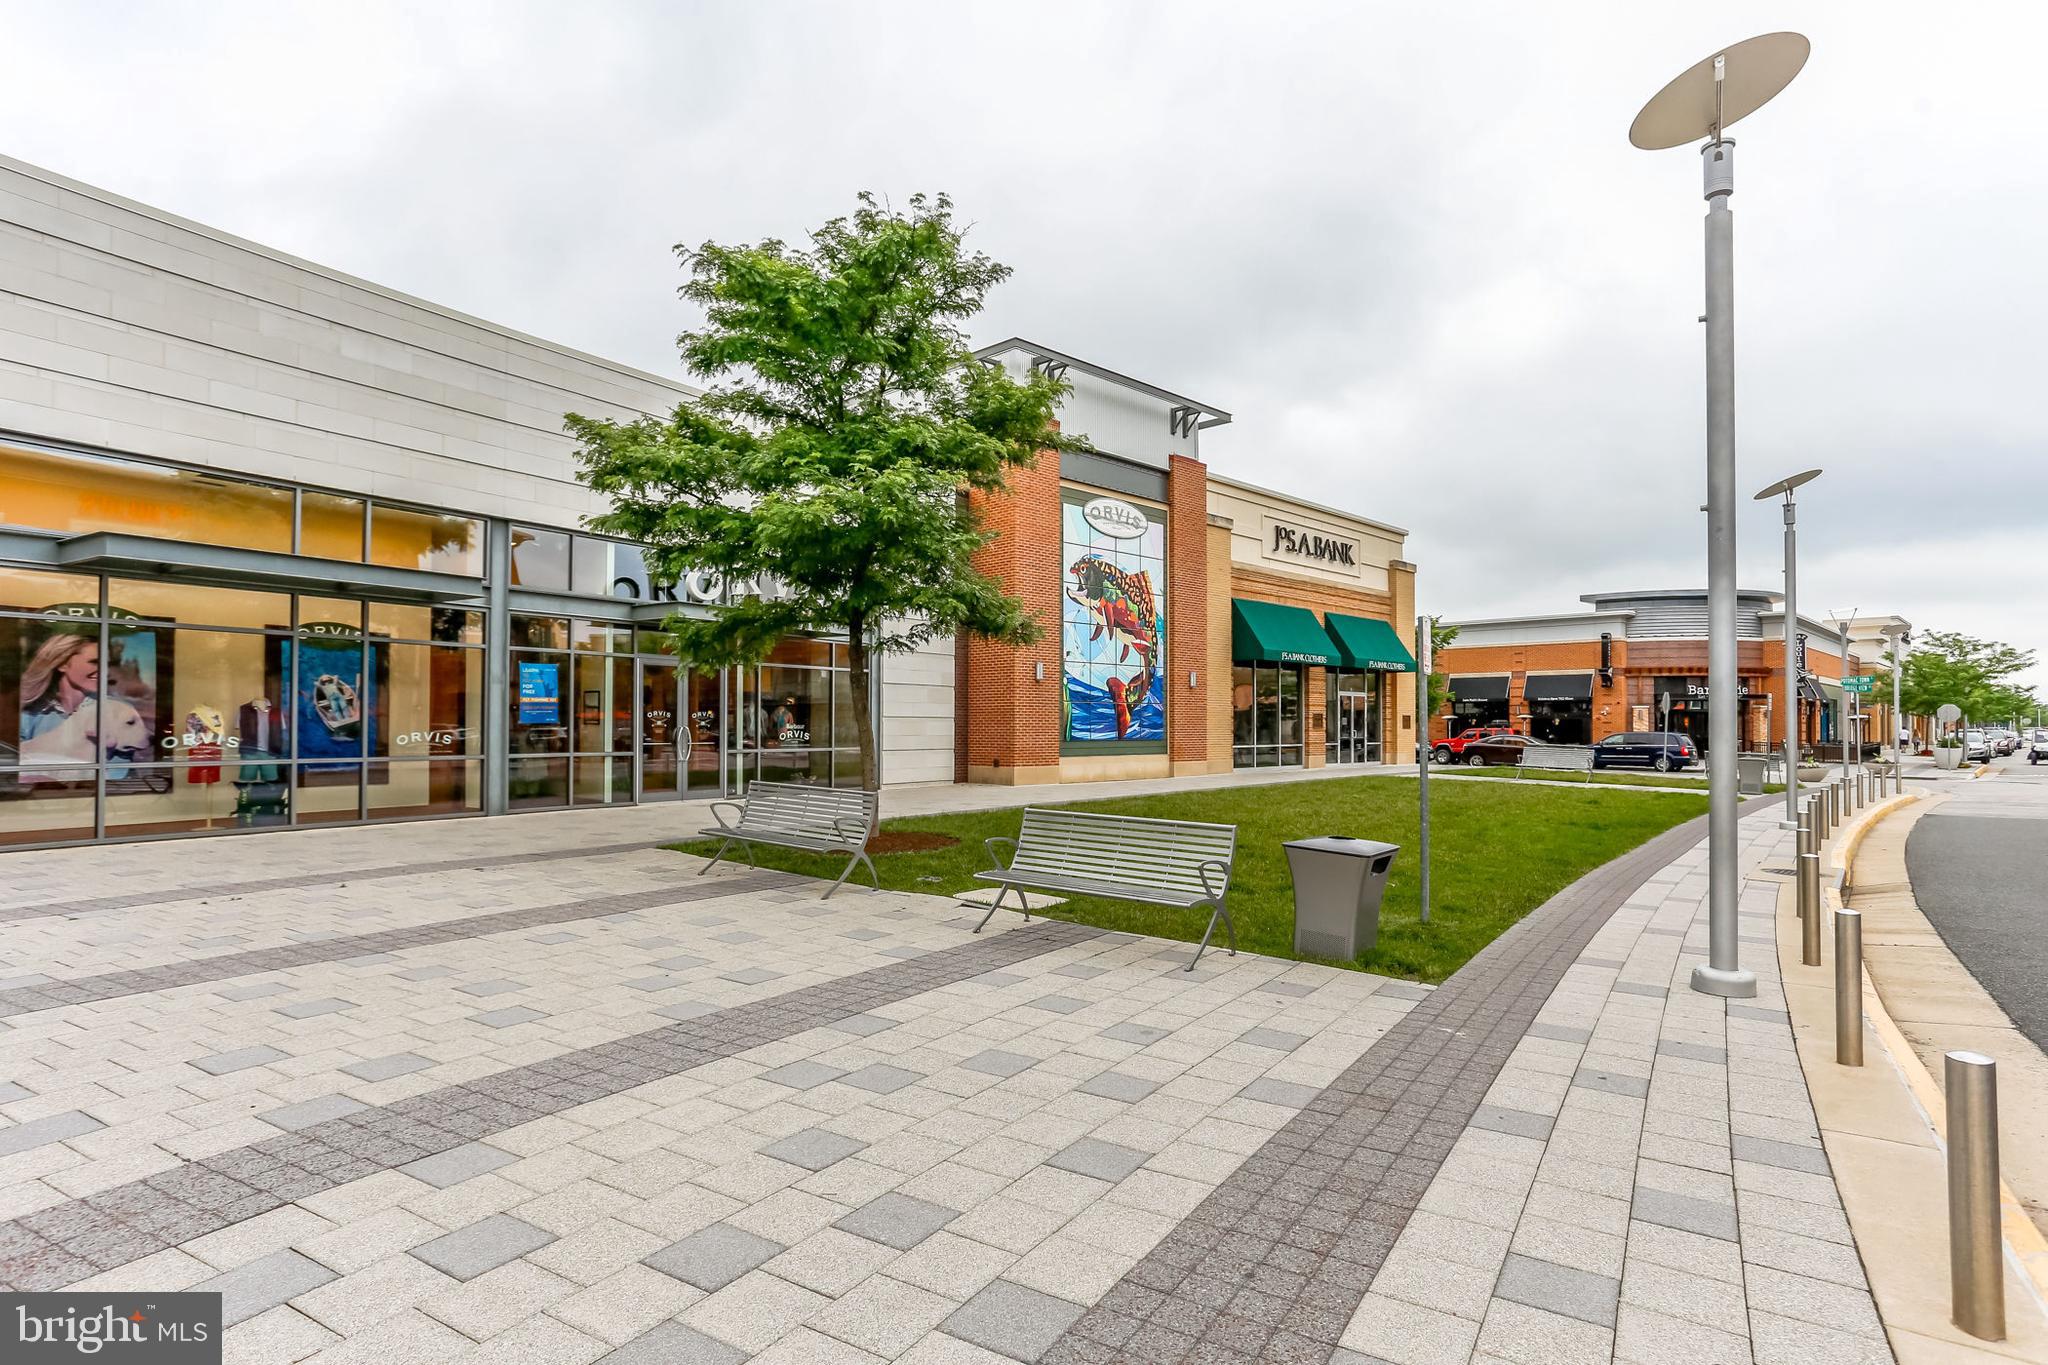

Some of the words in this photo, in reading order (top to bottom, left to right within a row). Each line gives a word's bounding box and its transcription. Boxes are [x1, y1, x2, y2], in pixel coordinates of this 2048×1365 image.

[1090, 506, 1143, 530] ORVIS
[646, 710, 671, 719] ORVIS
[161, 732, 240, 749] ORVIS
[396, 731, 453, 745] ORVIS
[779, 729, 810, 740] ORVIS
